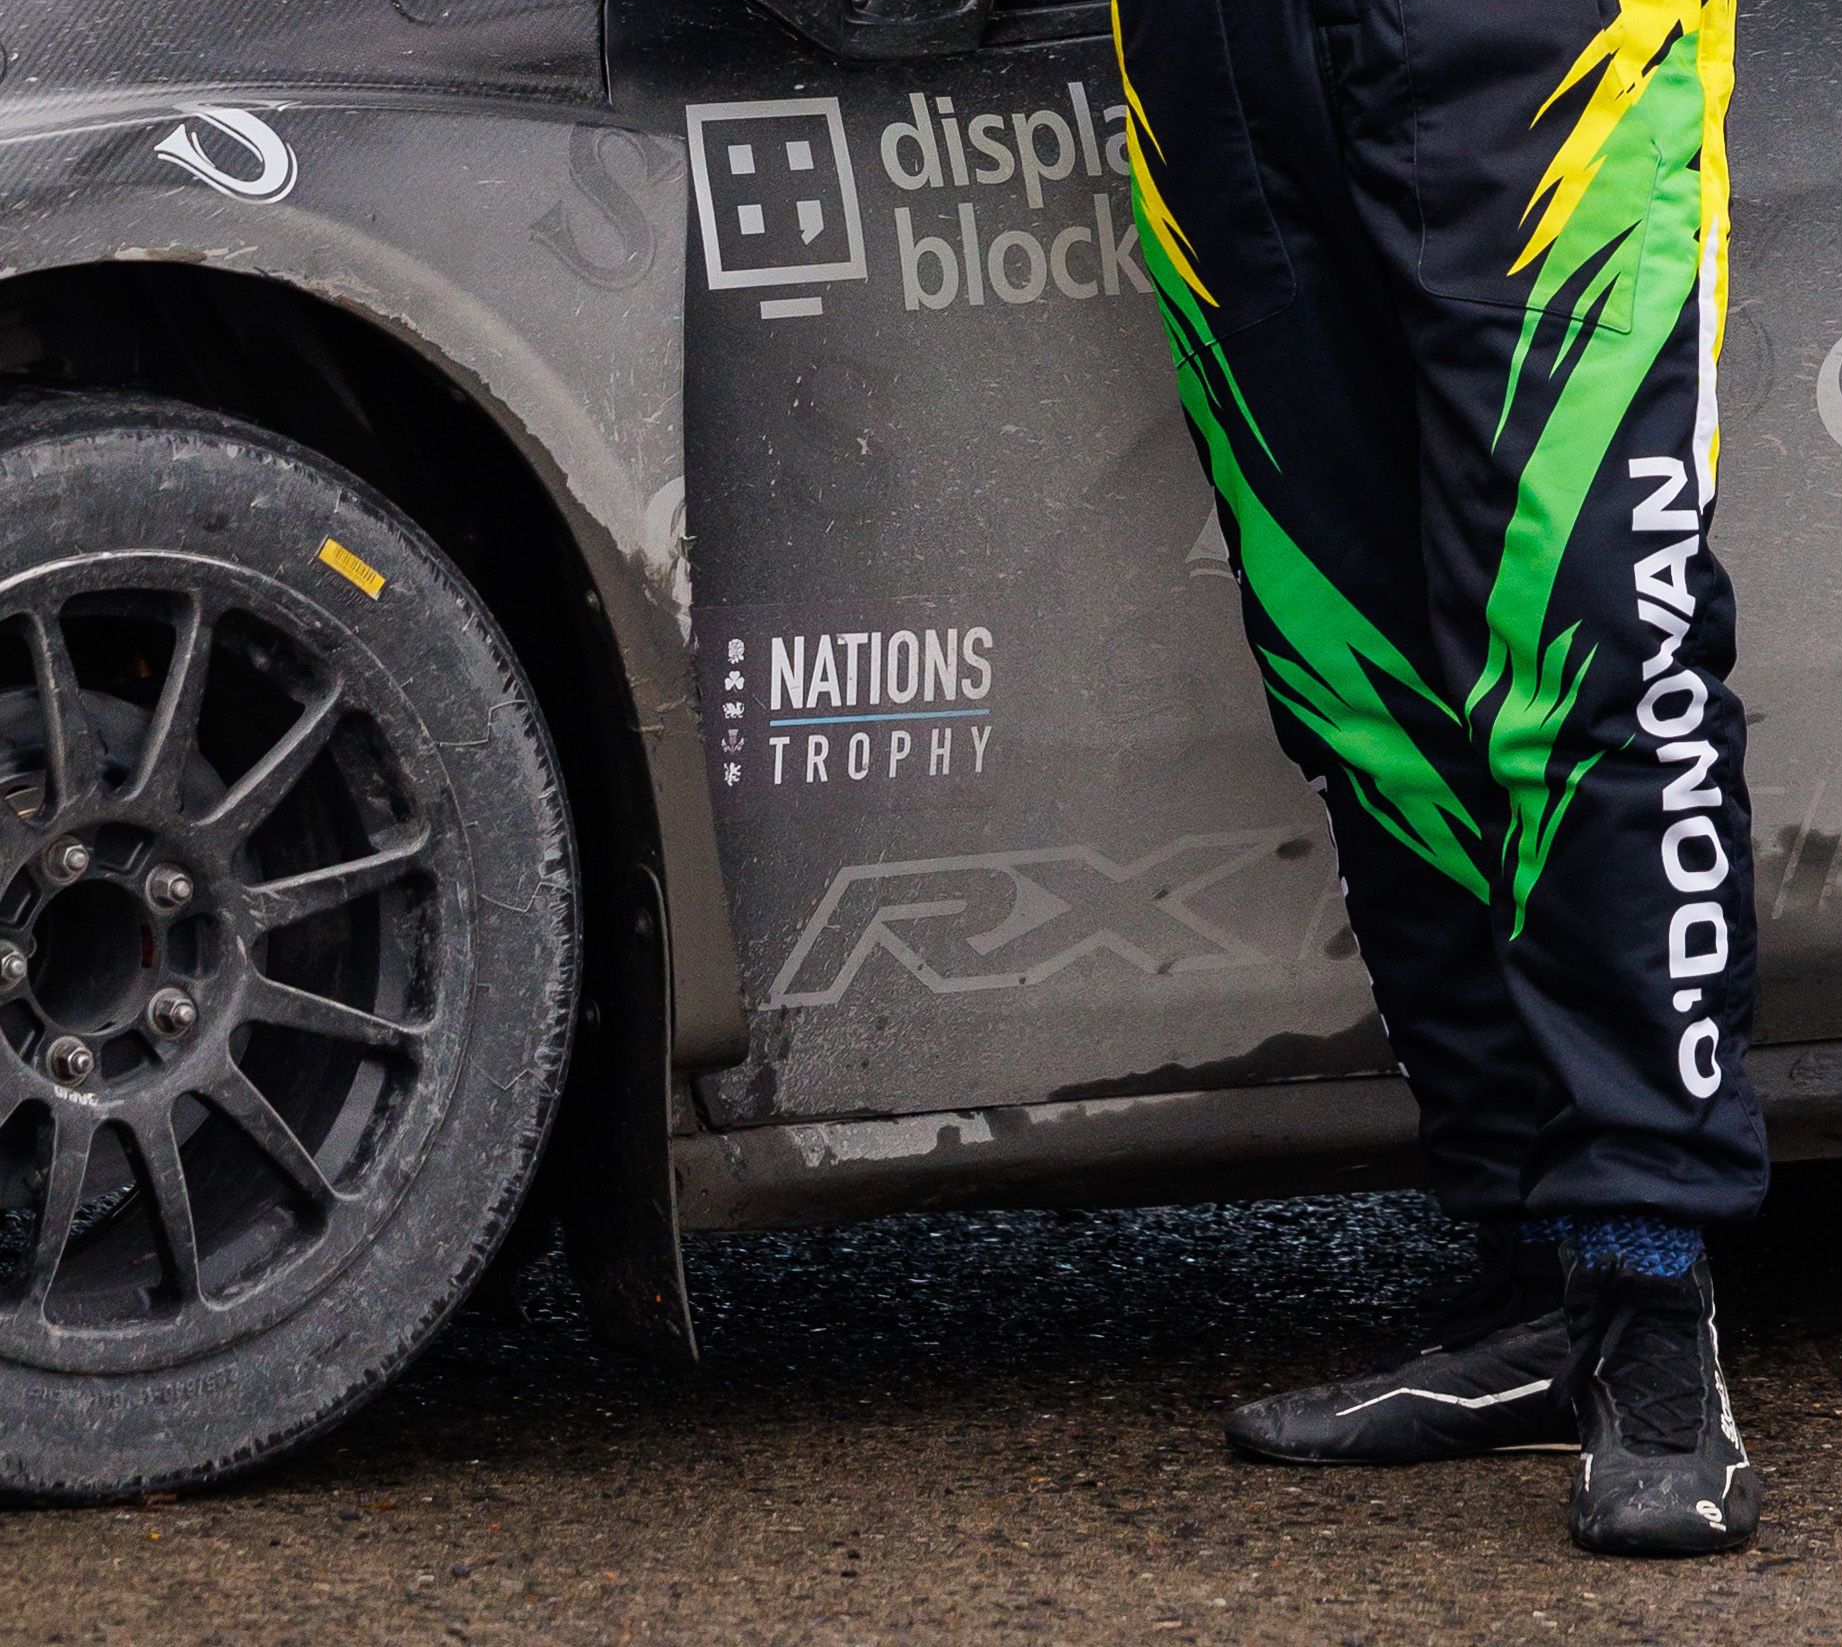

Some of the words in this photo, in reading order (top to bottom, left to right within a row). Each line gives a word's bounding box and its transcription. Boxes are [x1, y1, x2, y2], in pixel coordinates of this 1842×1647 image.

[880, 81, 1131, 209] displa
[894, 194, 1155, 311] block
[769, 626, 994, 711] NATIONS
[769, 726, 992, 785] TROPHY
[1628, 455, 1729, 1100] O'DONOVAN
